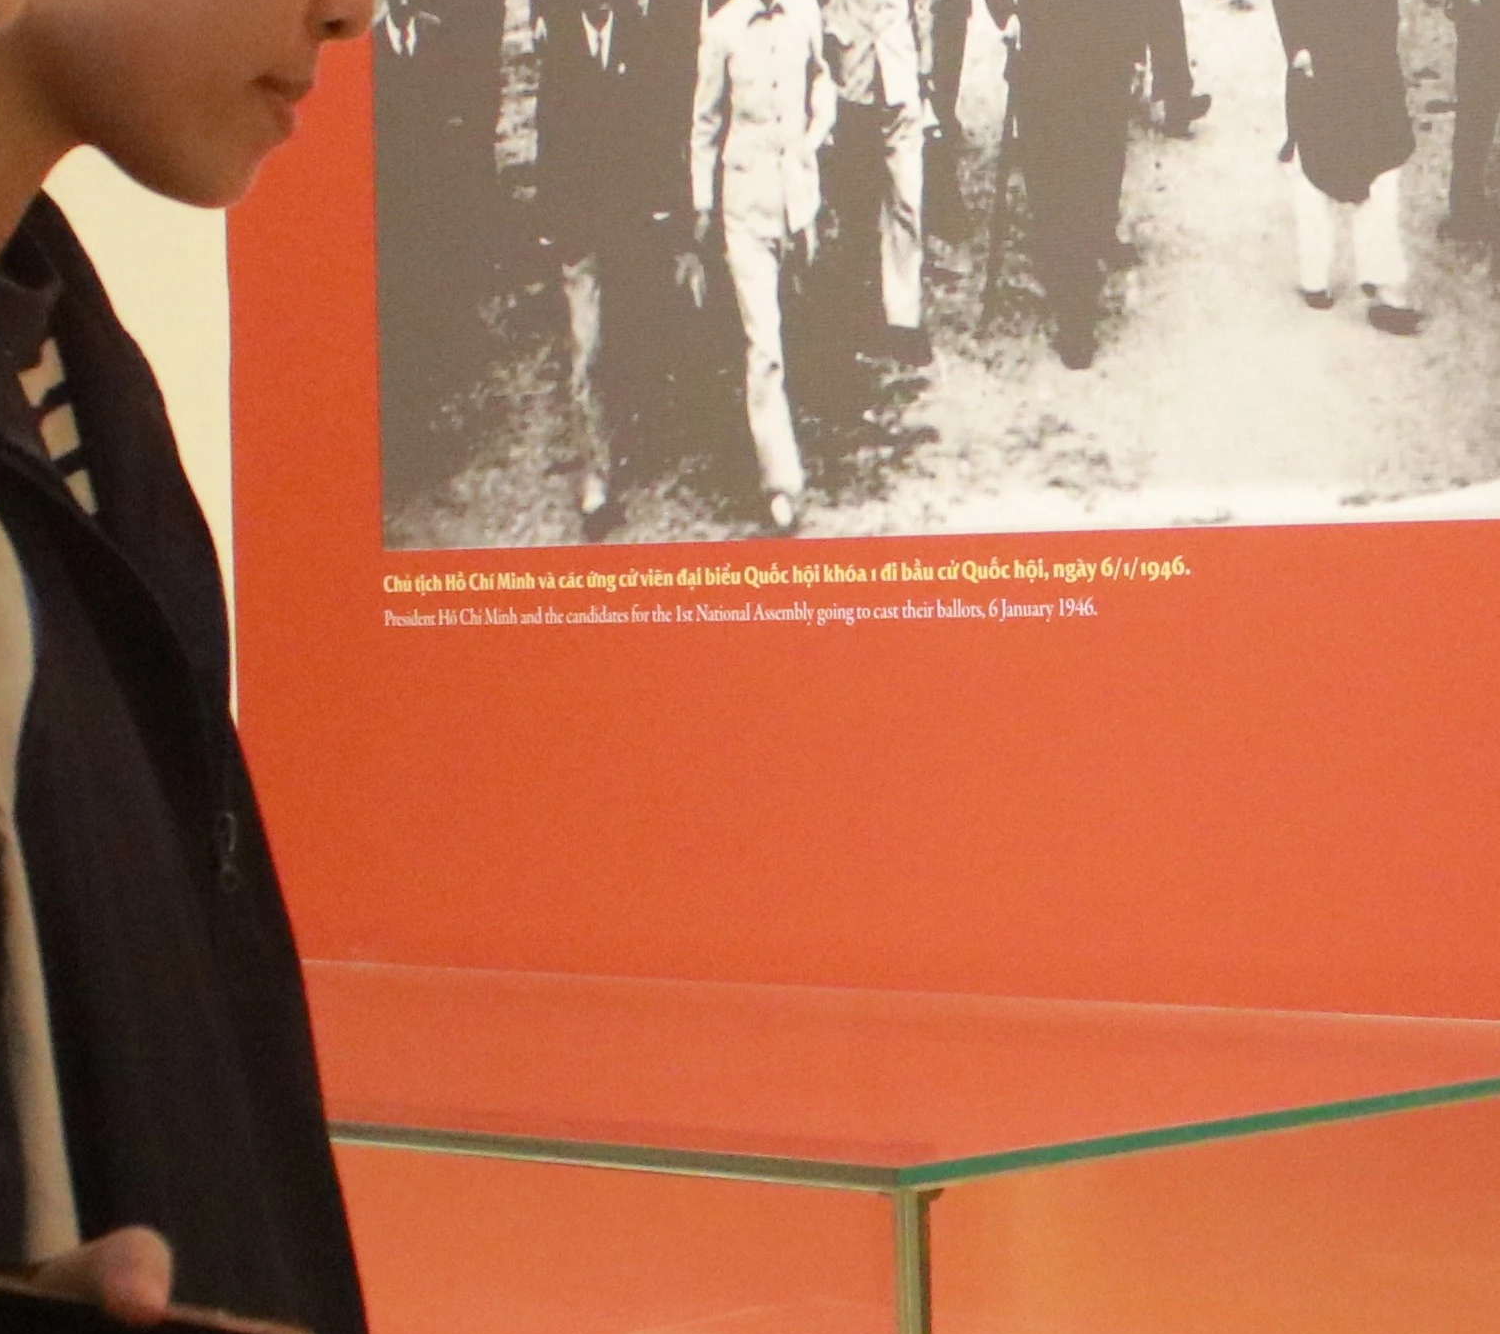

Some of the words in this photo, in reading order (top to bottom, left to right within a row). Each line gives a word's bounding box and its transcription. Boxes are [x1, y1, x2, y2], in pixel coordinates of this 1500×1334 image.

[382, 574, 413, 594] Chủ
[413, 573, 444, 596] tịch
[444, 571, 468, 592] Hồ
[468, 572, 496, 592] Chí
[496, 571, 537, 590] Minh
[537, 572, 557, 590] và
[557, 571, 585, 589] các
[586, 570, 618, 593] ứng
[618, 568, 640, 588] cử
[638, 568, 675, 587] viên
[675, 566, 703, 591] đại
[704, 562, 742, 586] biểu
[743, 562, 790, 589] Quốc
[792, 563, 821, 589] hội
[823, 563, 868, 583] khóa
[879, 561, 898, 582] đi
[900, 558, 935, 582] bầu
[936, 559, 961, 581] cử
[961, 556, 1011, 584] Quốc
[1013, 558, 1050, 584] hội,
[1052, 558, 1098, 583] ngày
[1100, 555, 1191, 582] 6/1/1946.
[519, 605, 544, 625] and
[543, 605, 565, 625] the
[565, 604, 630, 624] candidates
[630, 603, 651, 623] for
[651, 603, 673, 623] the
[675, 604, 694, 623] 1st
[695, 602, 751, 622] National
[752, 600, 815, 626] Assembly
[816, 607, 856, 626] going
[855, 606, 872, 620] to
[871, 605, 900, 620] cast
[901, 598, 935, 619] their
[936, 598, 987, 619] ballots,
[987, 598, 1000, 618] 6
[998, 598, 1055, 623] January
[1059, 596, 1098, 617] 1946.
